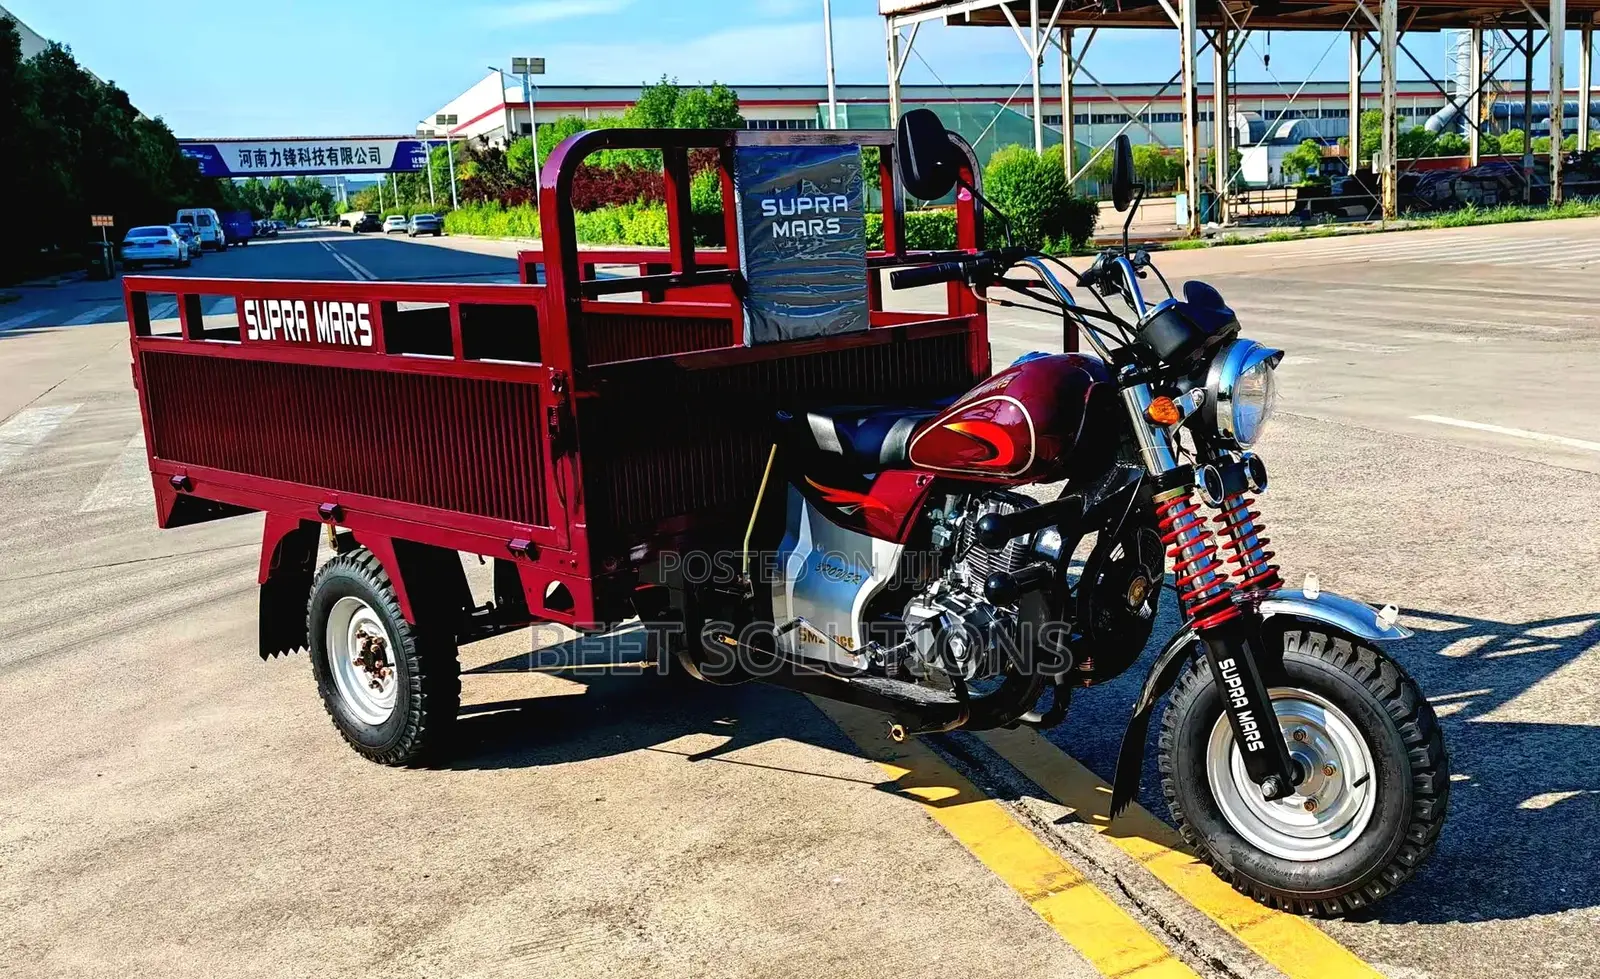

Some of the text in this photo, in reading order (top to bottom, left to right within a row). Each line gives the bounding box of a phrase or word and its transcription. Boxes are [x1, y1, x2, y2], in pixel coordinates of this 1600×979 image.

[238, 146, 382, 168] 河南力锋科技有限公司
[761, 195, 849, 217] SUPRA
[772, 218, 841, 238] MARS
[244, 299, 373, 347] SUPRA MARS
[1218, 657, 1266, 753] SUPRA MARS
